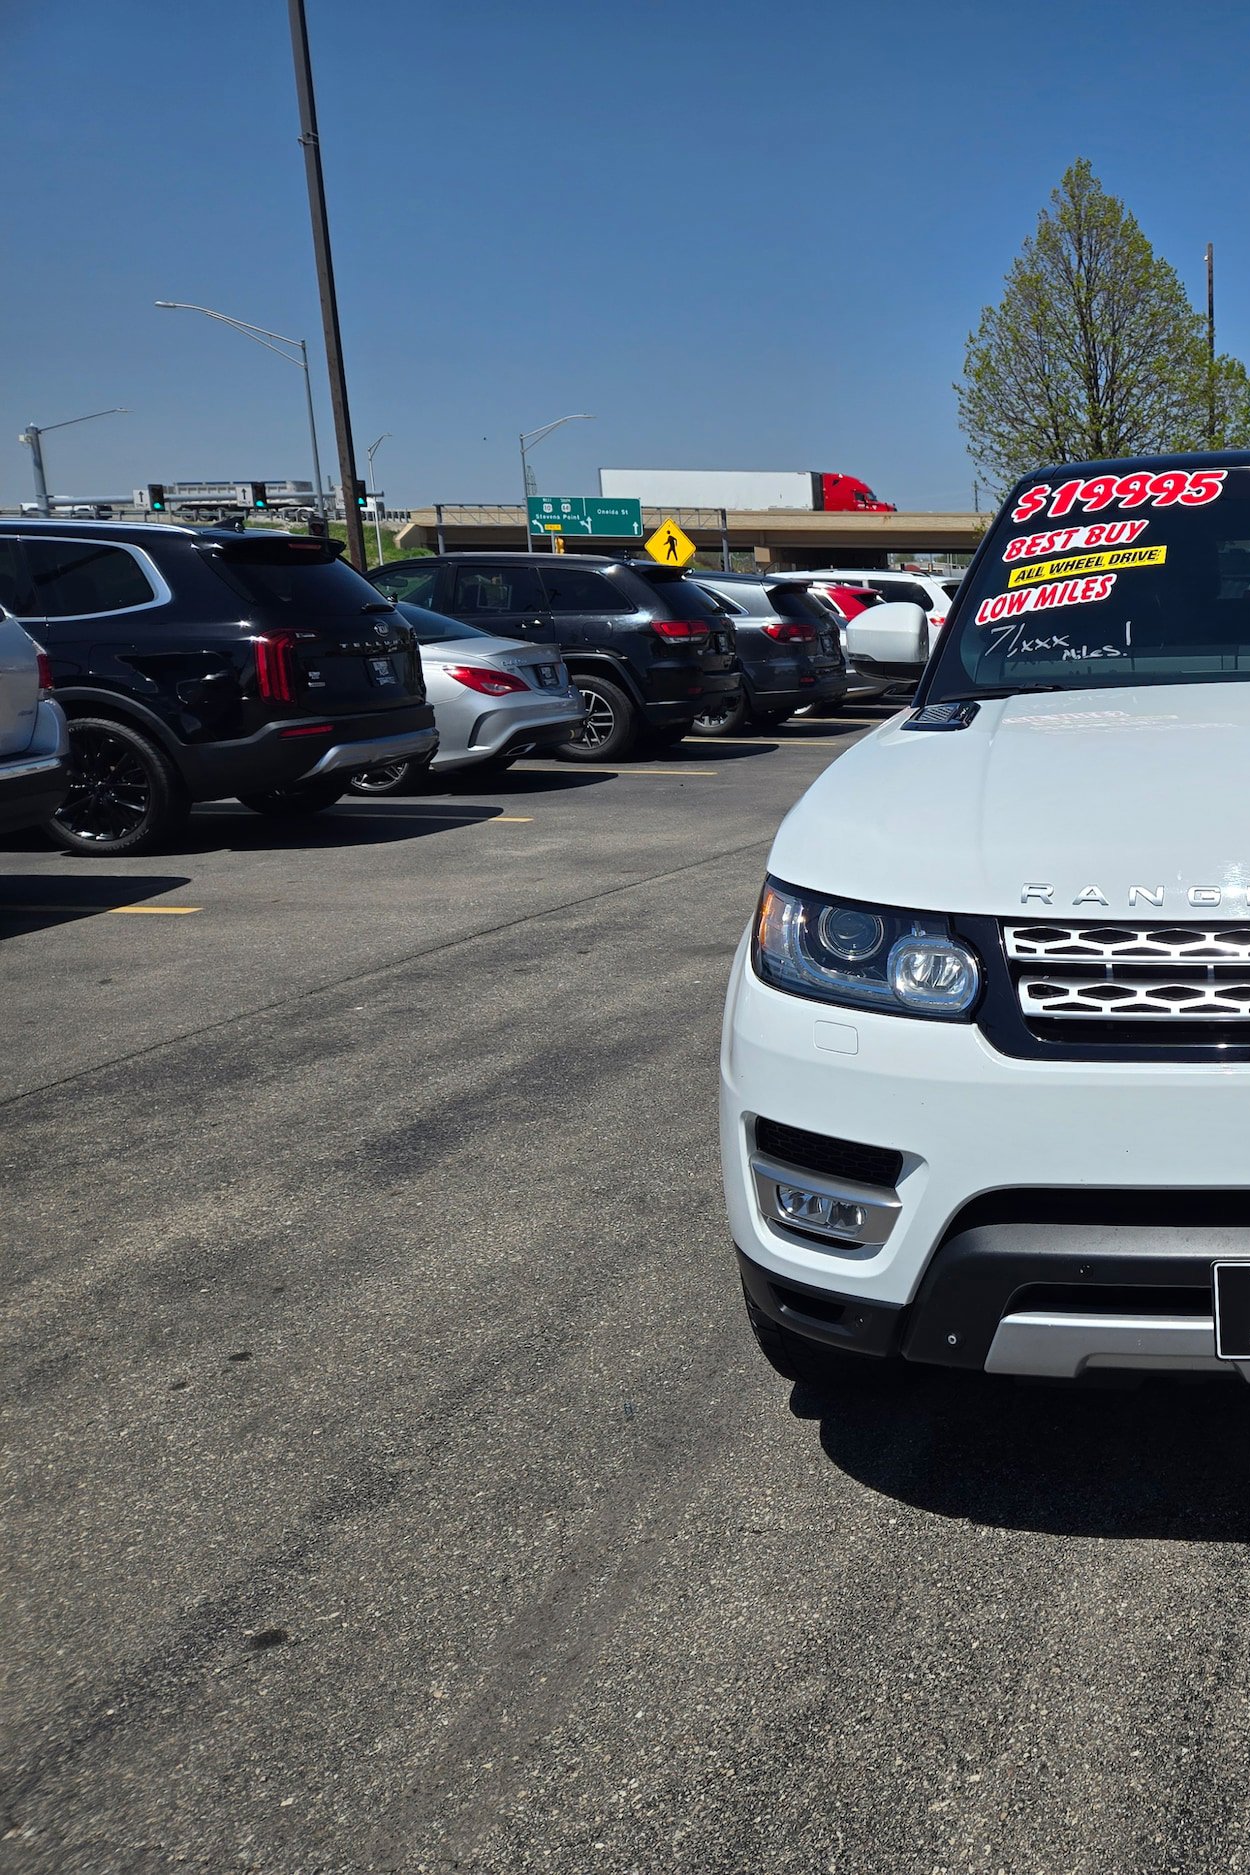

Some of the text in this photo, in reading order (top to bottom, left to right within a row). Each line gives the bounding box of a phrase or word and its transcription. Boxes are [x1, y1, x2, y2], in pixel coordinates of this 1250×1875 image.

[1011, 470, 1229, 523] $19995
[1003, 520, 1148, 561] BEST BUY
[1014, 549, 1161, 583] ALL WHEEL DRIVE
[975, 574, 1116, 625] LOW MILES
